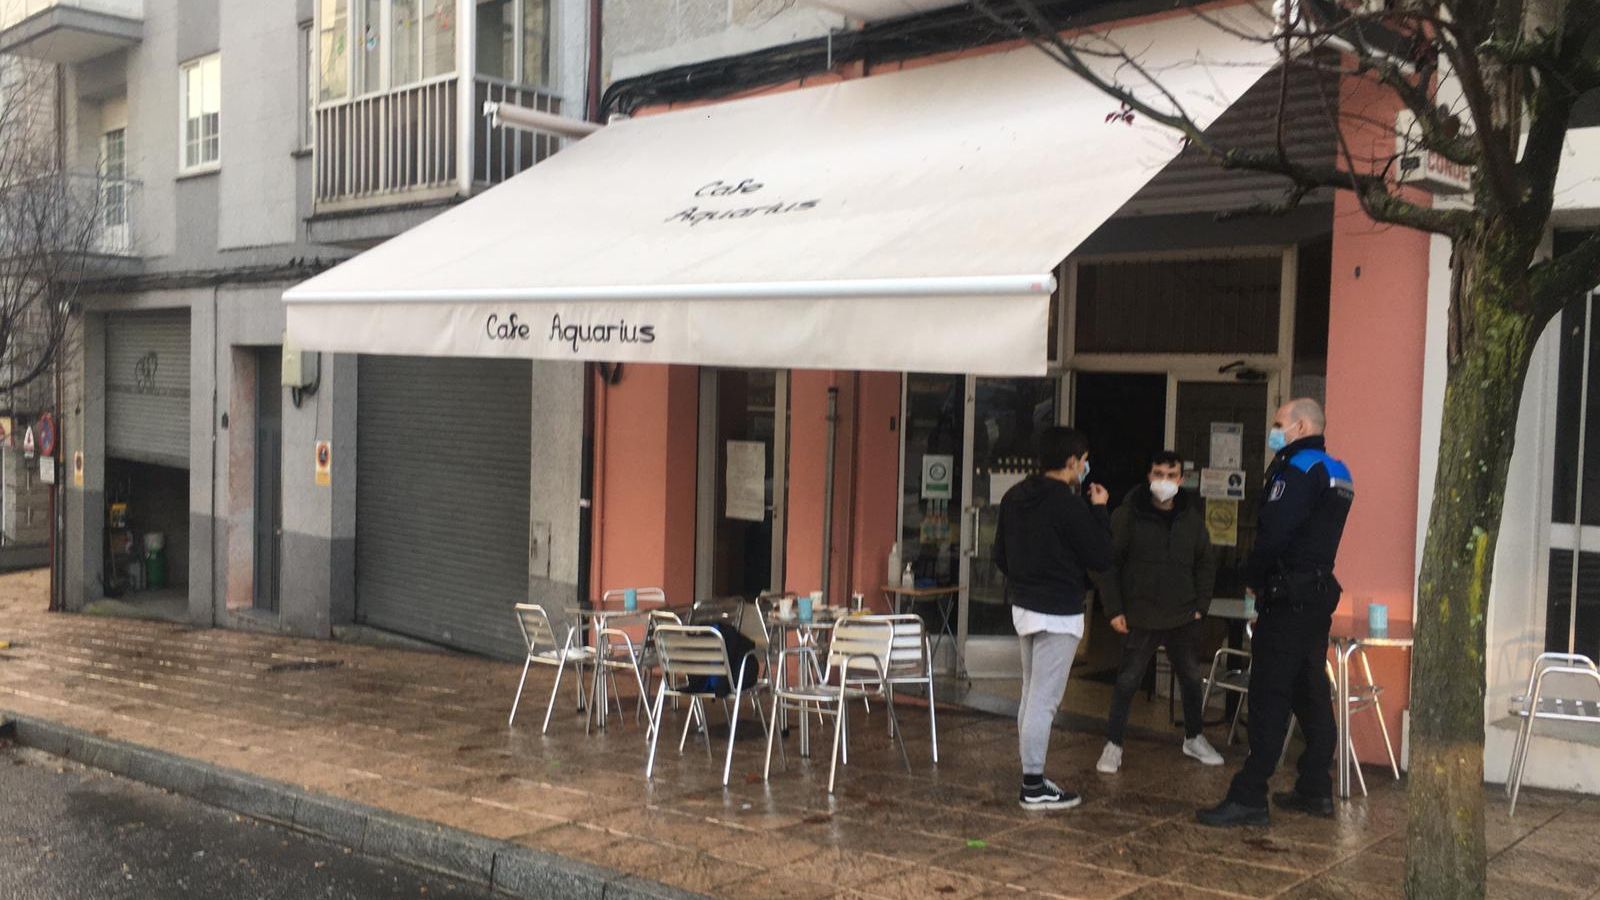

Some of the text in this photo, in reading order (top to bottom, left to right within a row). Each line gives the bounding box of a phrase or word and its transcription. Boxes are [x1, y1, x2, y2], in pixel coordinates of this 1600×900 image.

[694, 178, 764, 197] Cafe
[664, 199, 821, 227] Aquarius
[486, 312, 656, 352] Cafe Aquarius
